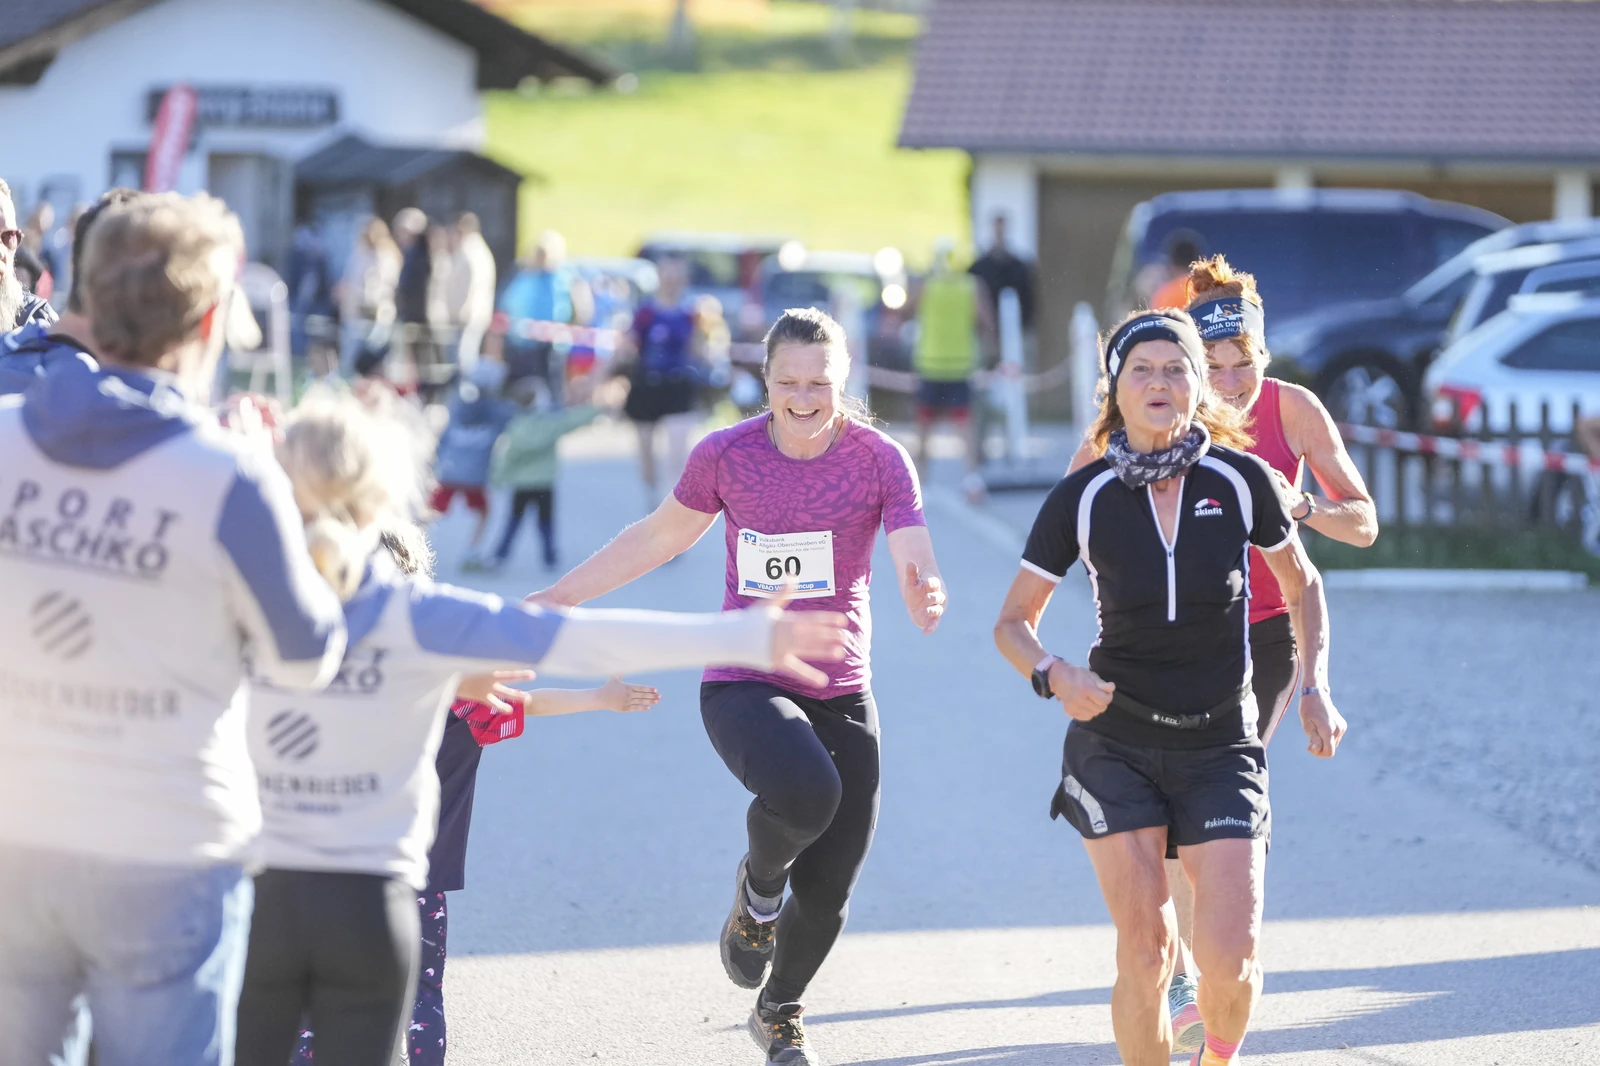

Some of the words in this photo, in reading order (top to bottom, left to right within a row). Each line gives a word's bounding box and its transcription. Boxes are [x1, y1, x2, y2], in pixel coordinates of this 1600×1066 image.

[1203, 322, 1224, 335] AQUA
[1194, 507, 1223, 517] skinfit
[765, 555, 801, 580] 60
[757, 583, 774, 591] VBAO
